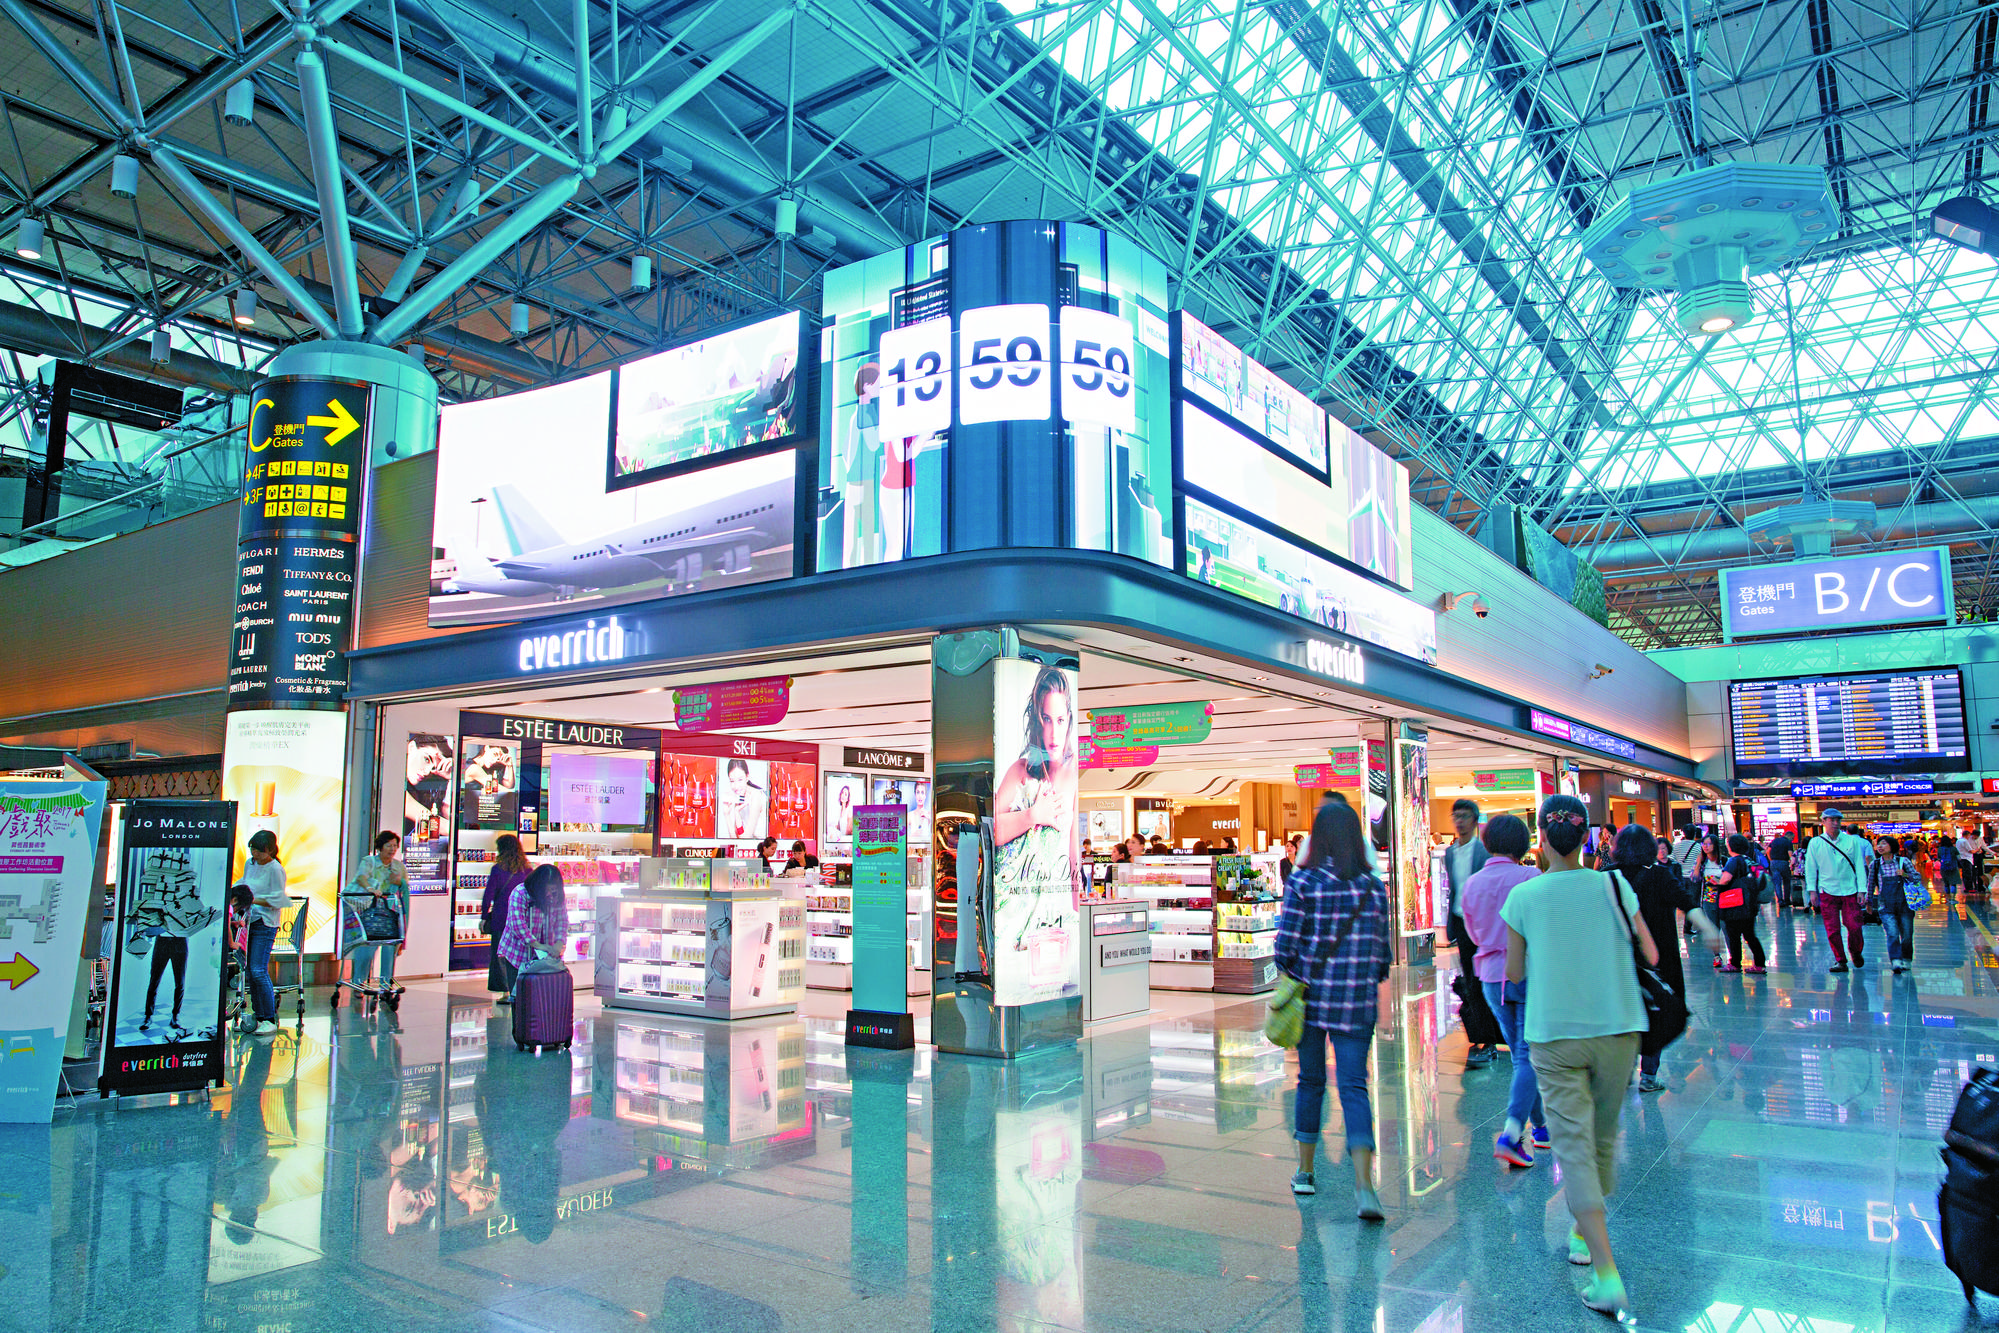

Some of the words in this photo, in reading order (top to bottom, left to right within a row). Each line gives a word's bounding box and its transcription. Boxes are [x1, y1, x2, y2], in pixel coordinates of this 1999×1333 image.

[969, 336, 1042, 390] 59
[1071, 339, 1130, 398] 59
[249, 398, 275, 452] C
[273, 424, 305, 436] 登機門
[272, 437, 304, 448] Gates
[252, 463, 266, 480] 4F
[250, 487, 264, 504] 3F
[239, 547, 278, 562] BVLGARI
[242, 564, 263, 577] FENDI
[241, 582, 262, 596] Chloé
[309, 590, 349, 600] LAURENT
[1738, 582, 1795, 604] 登機門
[237, 602, 267, 613] COACH
[1740, 605, 1774, 616] Gates
[250, 618, 274, 626] BURCH
[519, 616, 624, 671] everrich
[295, 654, 327, 662] MONT
[1307, 638, 1364, 684] everrich
[243, 664, 268, 673] LAUREN
[294, 663, 326, 672] BLANC
[274, 676, 306, 684] Cosmetic
[314, 678, 346, 687] Fragrance
[559, 724, 623, 745] LAUDER
[734, 740, 756, 756] SK-II
[858, 752, 903, 767] LANCÔME
[596, 786, 624, 794] LAUDER
[684, 849, 712, 858] CLINIQUE
[1002, 853, 1051, 884] Miss
[1058, 854, 1080, 882] Di
[853, 1025, 878, 1035] everrich
[122, 1054, 179, 1072] everrich
[182, 1052, 207, 1060] dutyfree
